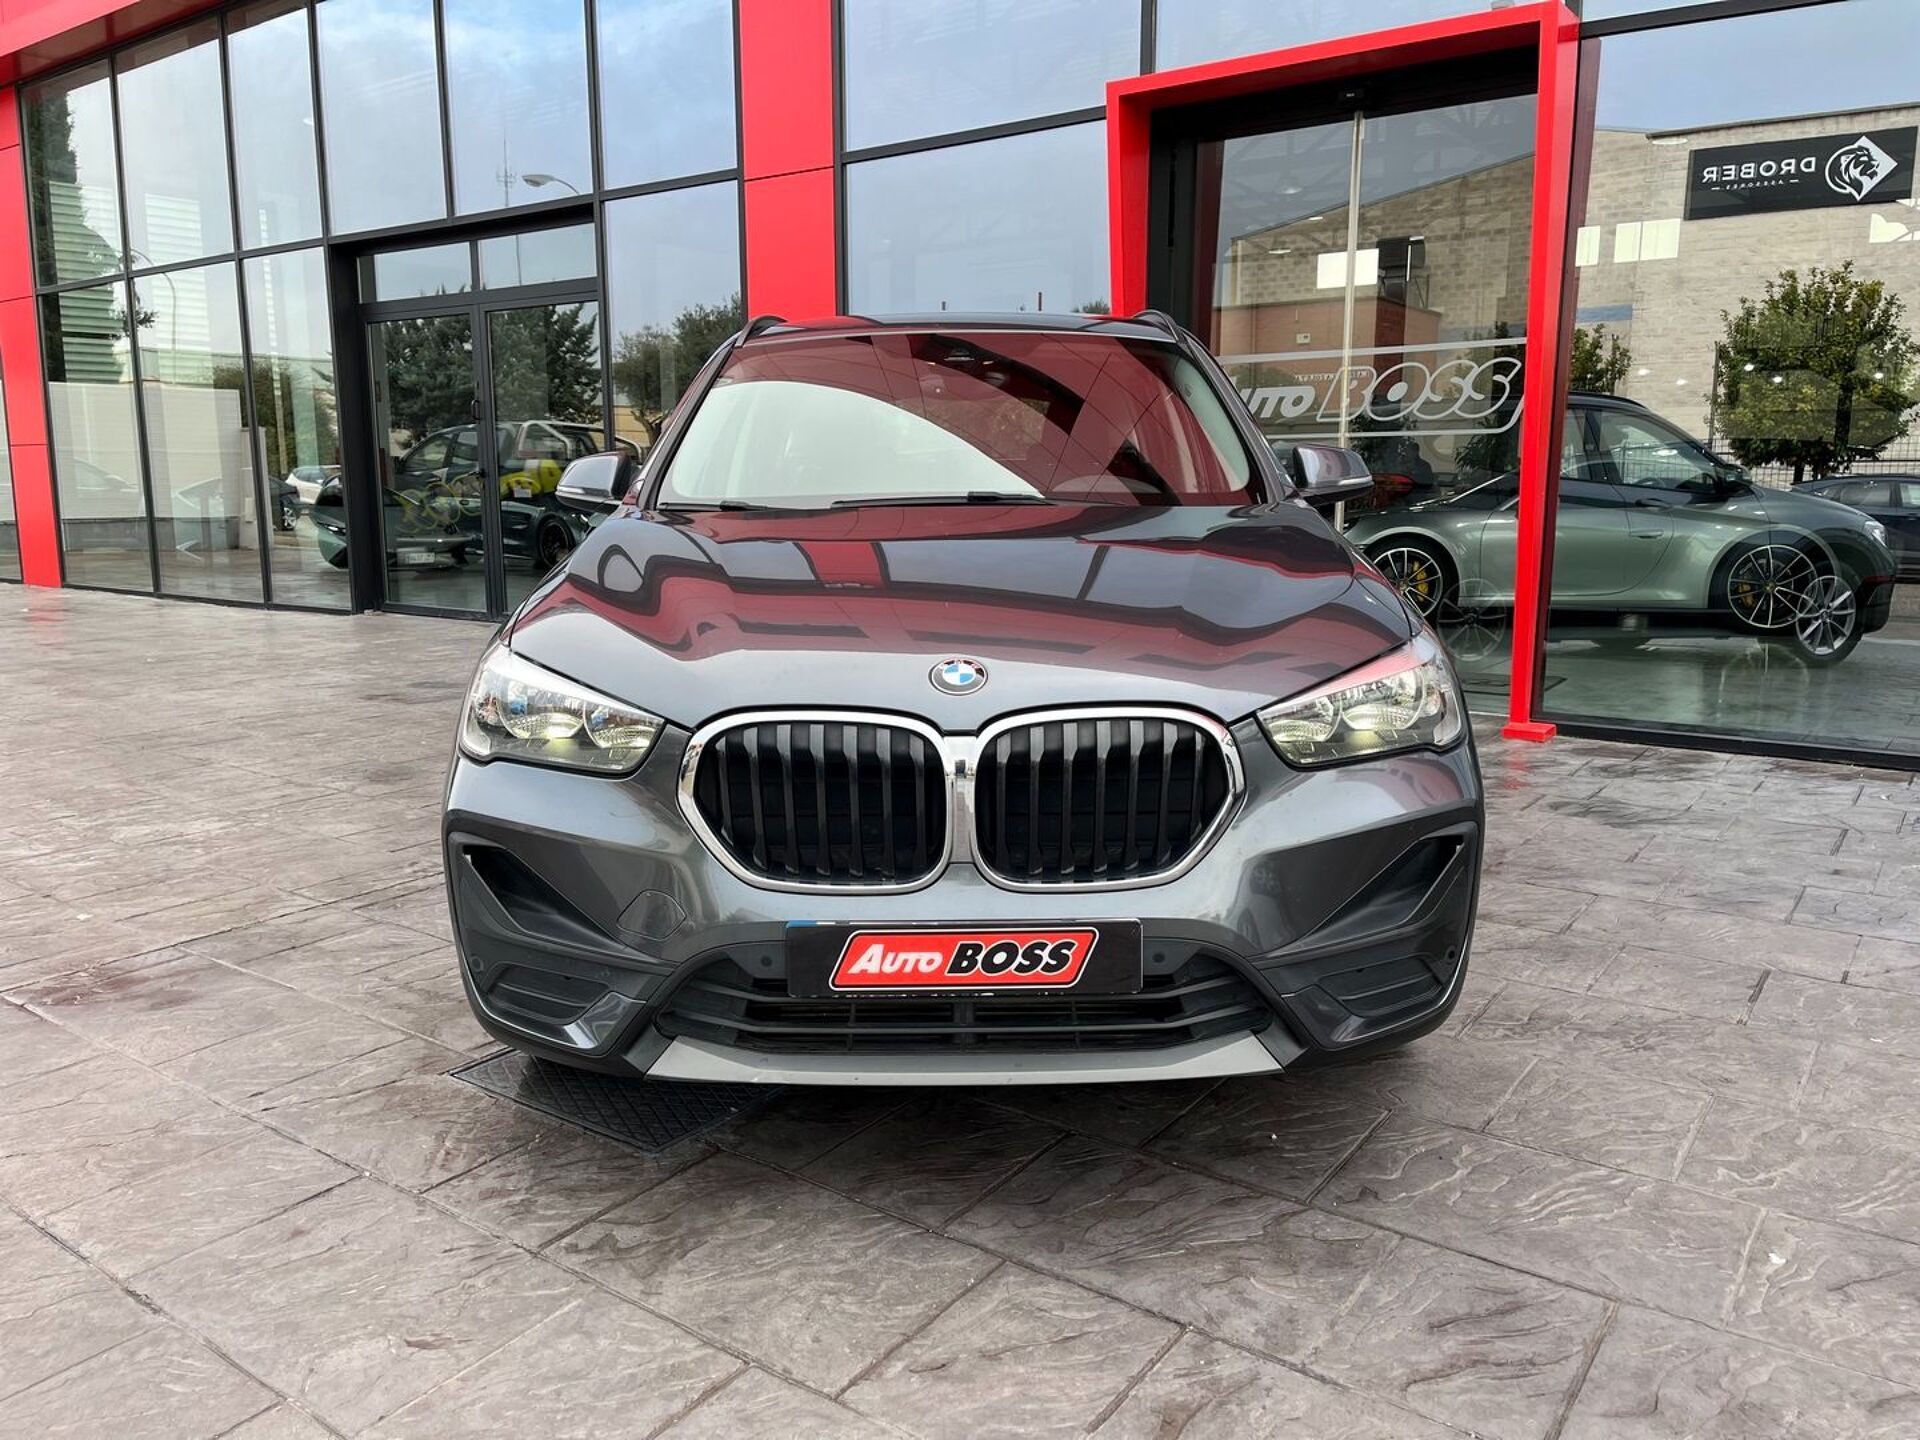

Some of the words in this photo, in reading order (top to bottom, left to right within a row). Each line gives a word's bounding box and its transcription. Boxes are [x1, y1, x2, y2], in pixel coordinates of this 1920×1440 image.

[1231, 376, 1316, 418] UTO
[1316, 357, 1521, 422] BOSS
[946, 940, 1077, 976] BOSS
